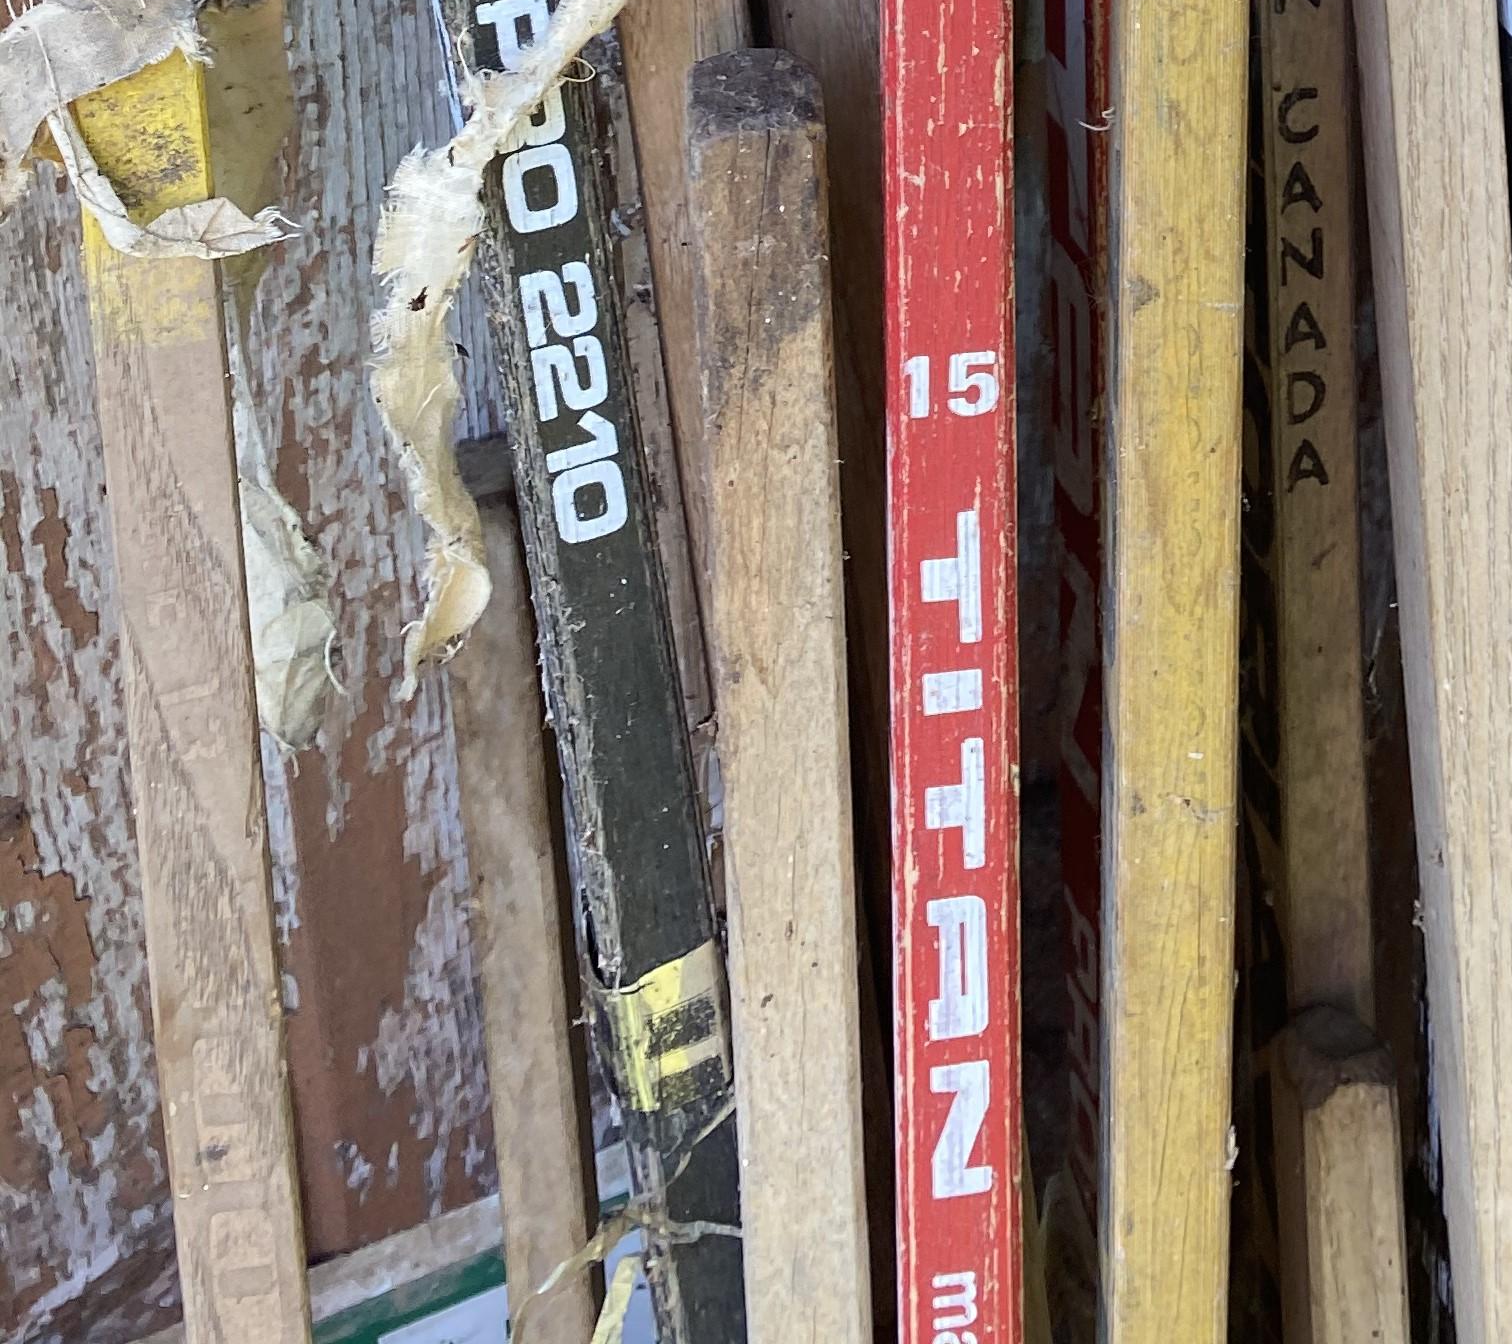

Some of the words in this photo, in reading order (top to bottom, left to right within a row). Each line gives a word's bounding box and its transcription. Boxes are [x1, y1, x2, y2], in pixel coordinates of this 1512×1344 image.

[519, 262, 629, 545] 2210
[901, 350, 1000, 419] 15
[1276, 86, 1331, 494] CANADA
[919, 509, 993, 1200] TITAN
